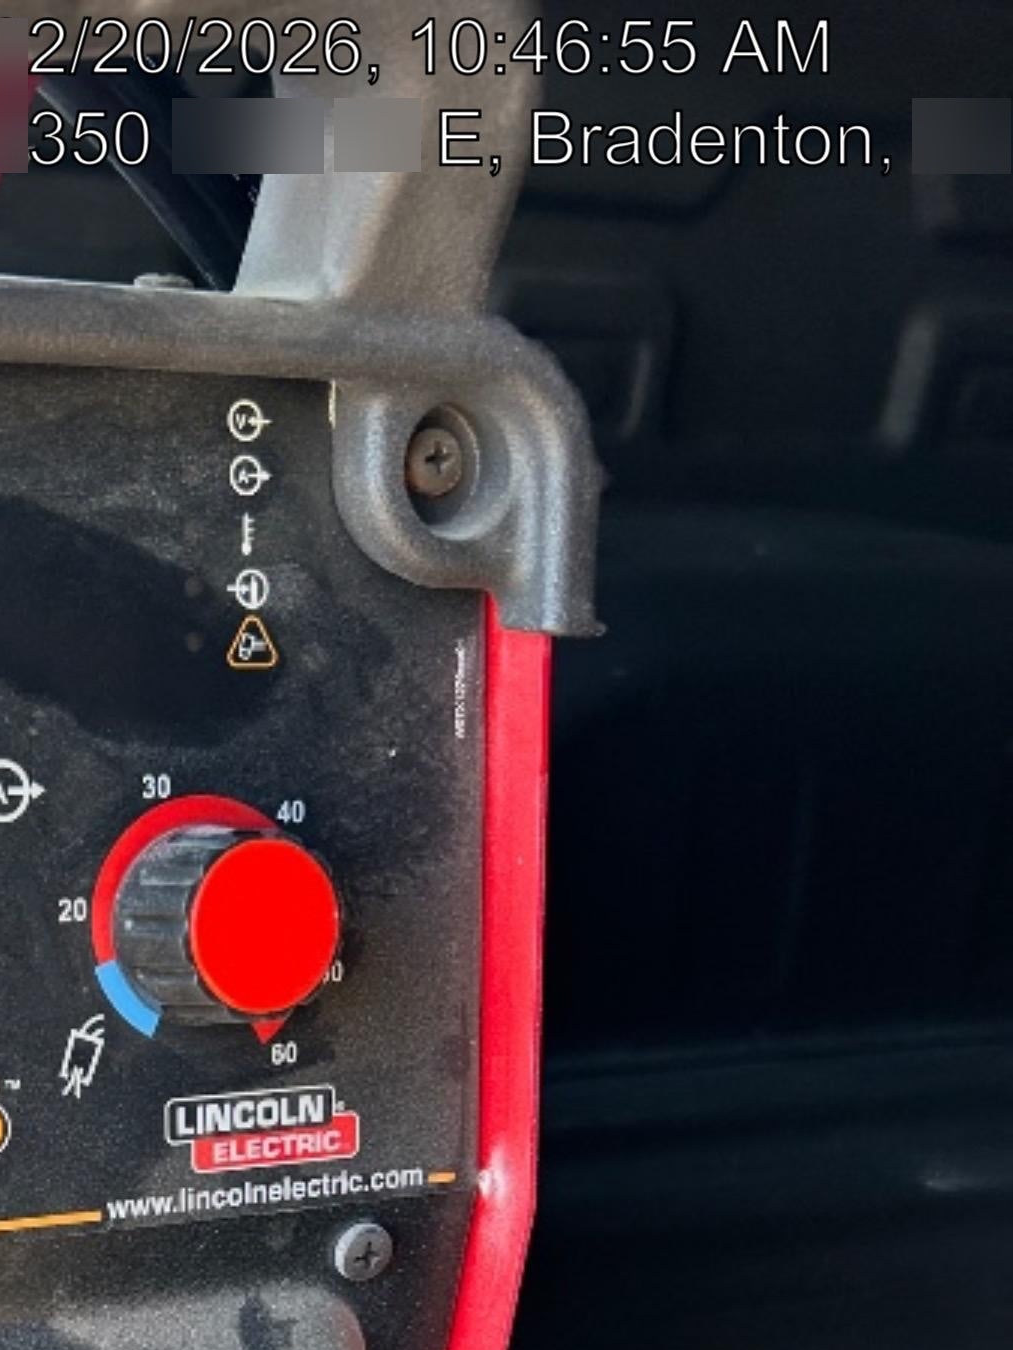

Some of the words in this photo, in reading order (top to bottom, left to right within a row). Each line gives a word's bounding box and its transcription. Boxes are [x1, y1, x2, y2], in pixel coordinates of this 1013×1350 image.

[142, 774, 172, 799] 30
[277, 801, 306, 824] 40
[58, 898, 87, 922] 20
[271, 1043, 298, 1065] 60
[175, 1094, 325, 1136] LINCOLN
[212, 1130, 342, 1164] ELECTRIC
[106, 1168, 424, 1220] www.lincolnelectric.com
